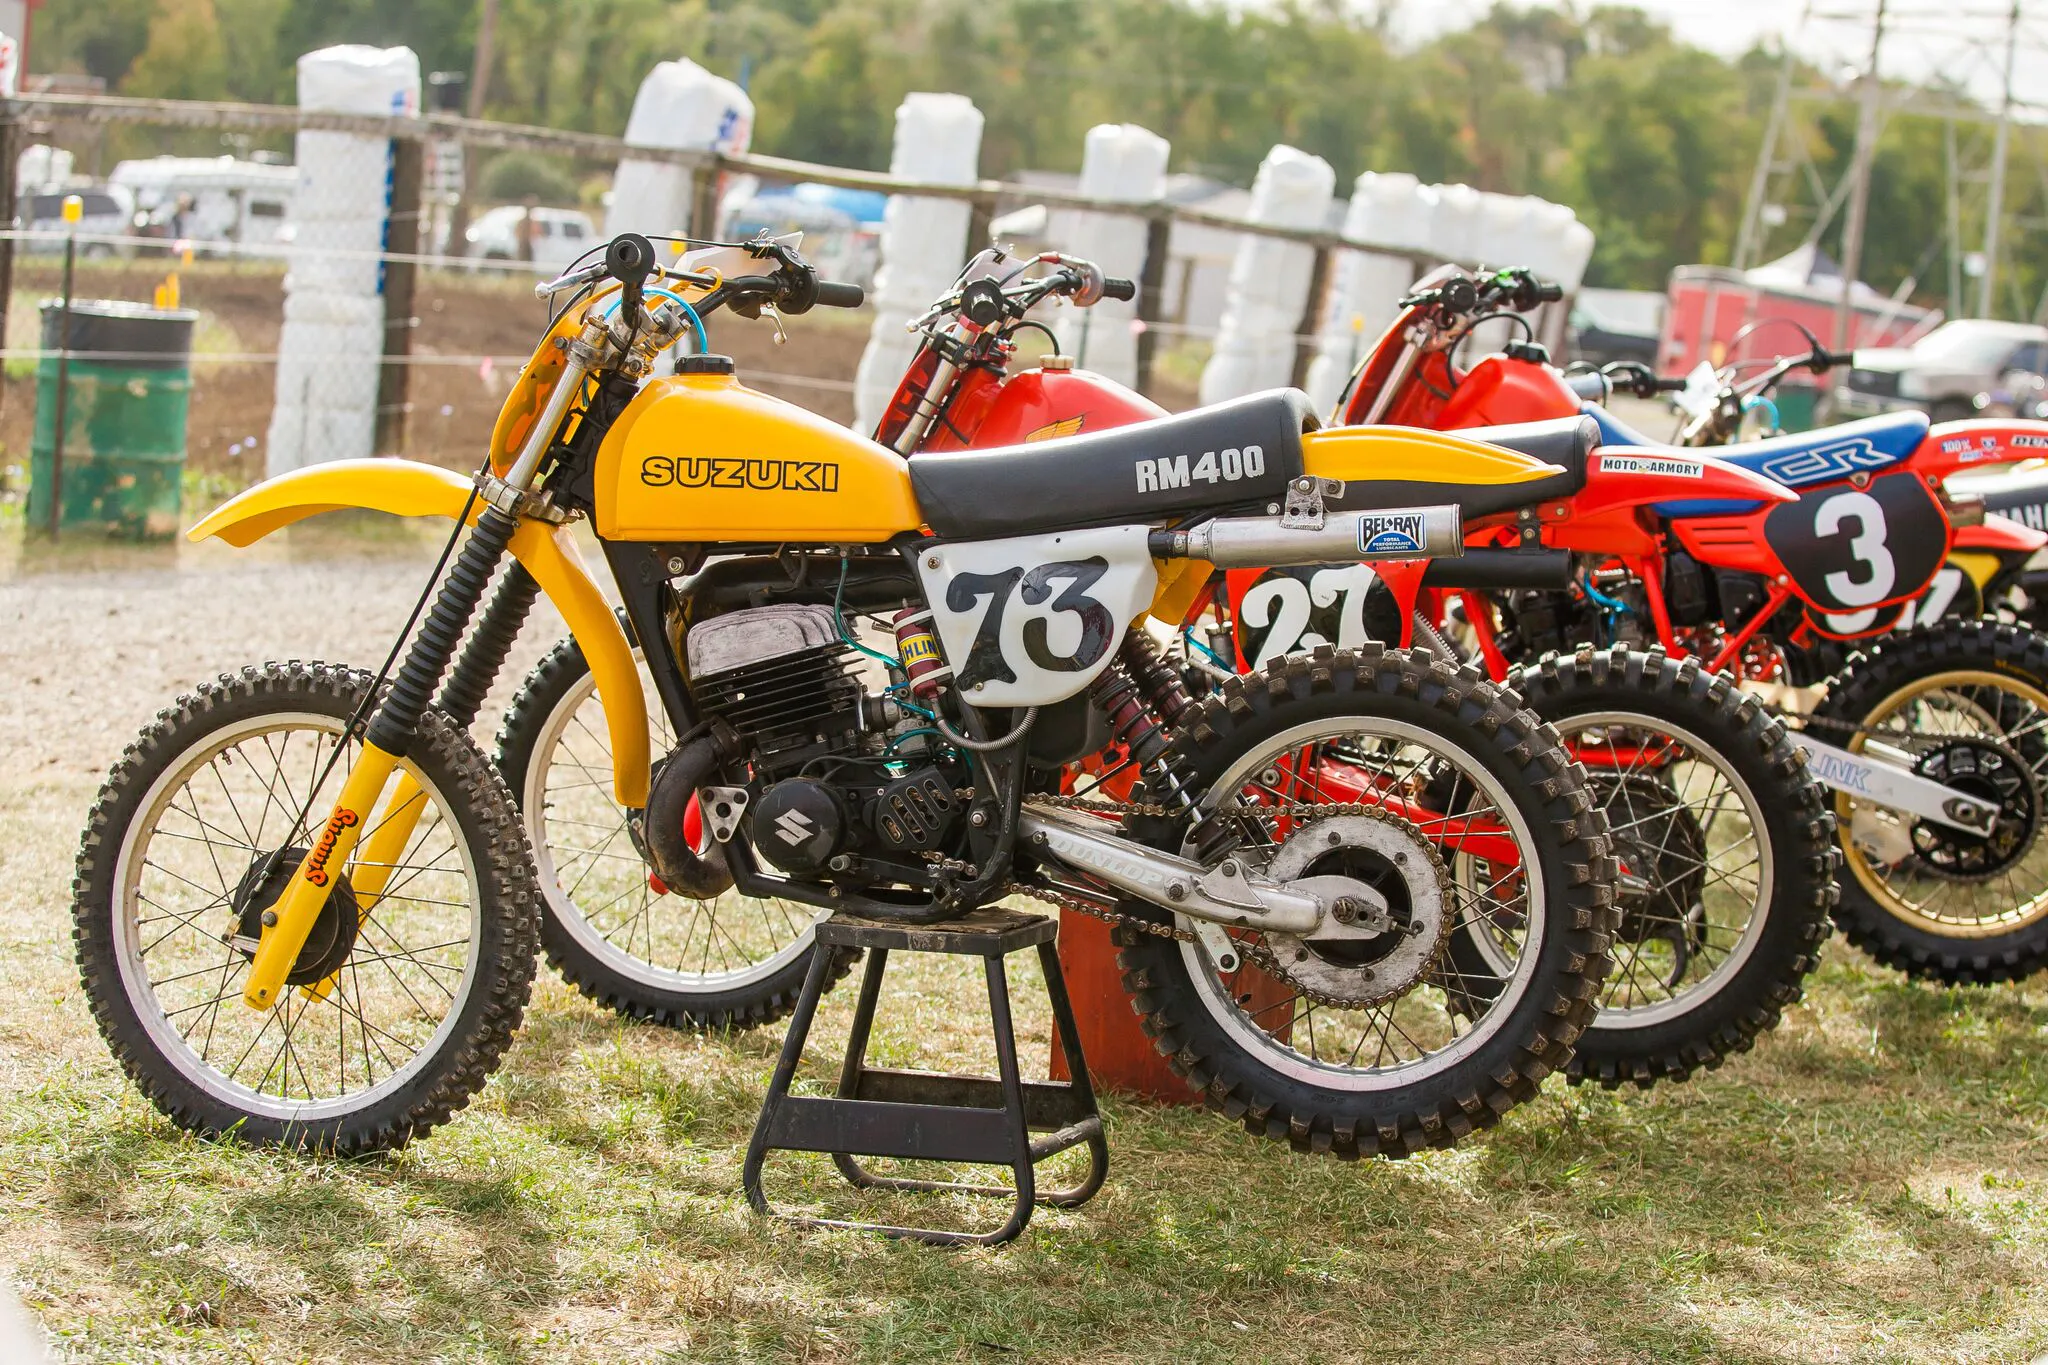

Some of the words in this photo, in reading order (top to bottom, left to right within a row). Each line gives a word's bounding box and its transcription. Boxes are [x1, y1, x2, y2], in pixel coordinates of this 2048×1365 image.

[641, 456, 839, 492] SUZUKI
[1603, 459, 1637, 472] MOTO
[1650, 462, 1700, 475] ARMORY
[1762, 438, 1897, 485] CR
[1814, 491, 1896, 607] 3
[946, 555, 1114, 692] 73
[1242, 563, 1376, 671] 27
[901, 639, 938, 662] HLIN
[1056, 839, 1164, 885] DUNLOP
